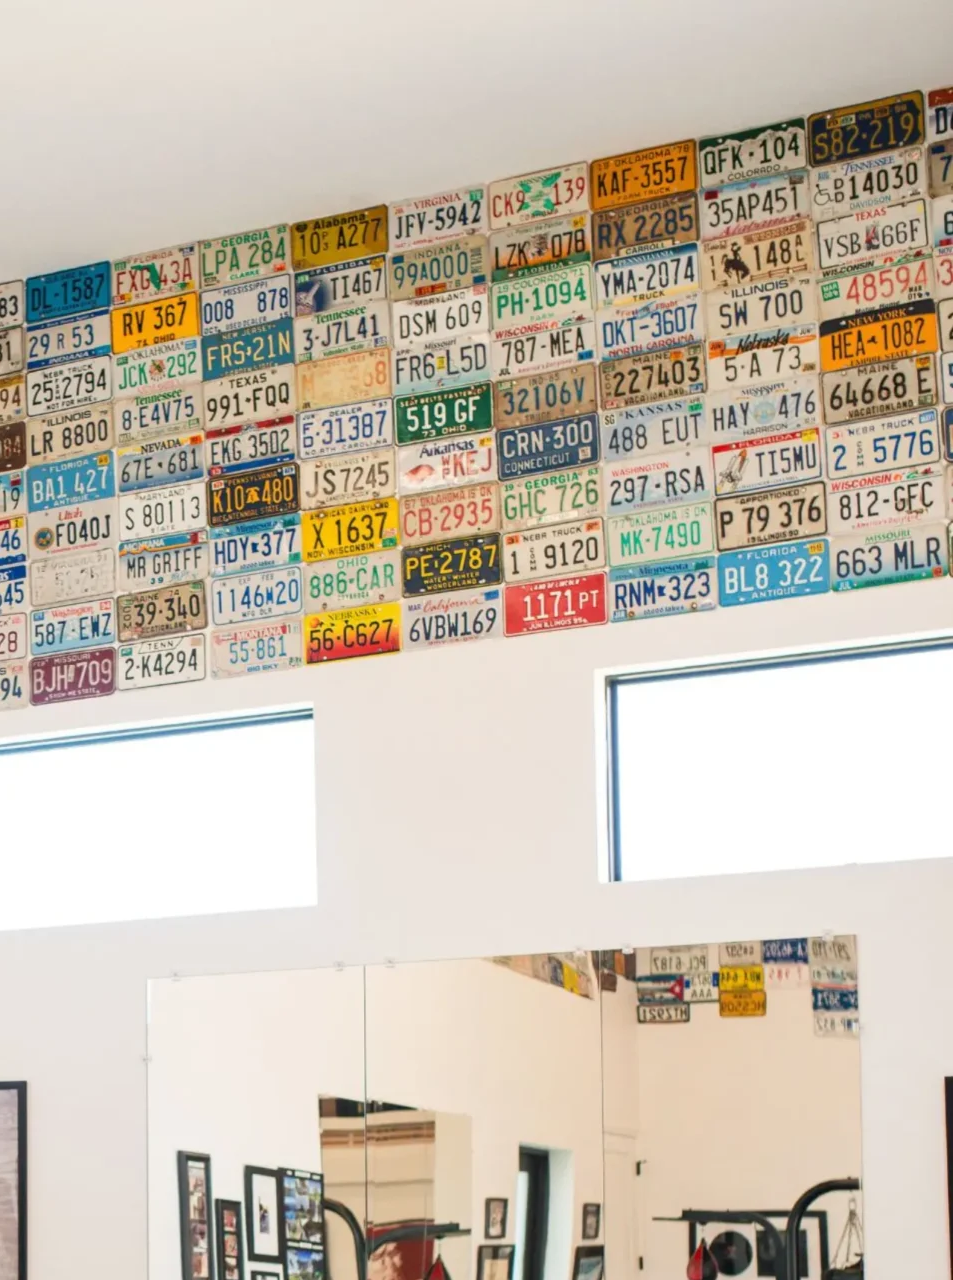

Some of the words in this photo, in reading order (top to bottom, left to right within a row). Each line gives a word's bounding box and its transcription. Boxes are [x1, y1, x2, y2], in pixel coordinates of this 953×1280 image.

[597, 156, 686, 196] KAF-3557
[727, 164, 781, 181] COLORADO
[849, 162, 917, 199] 14030
[414, 193, 460, 208] VIRGINIA
[709, 185, 797, 226] 35AP451
[855, 206, 886, 221] TEXAS
[313, 211, 366, 230] Alabama
[337, 217, 380, 248] A277
[396, 200, 480, 238] JFV-5942
[598, 220, 627, 248] RX
[632, 205, 694, 241] 2285
[221, 231, 268, 247] GEORGIA
[414, 243, 460, 258] INDIANA
[202, 247, 240, 276] LPA
[248, 237, 285, 267] 284
[223, 281, 267, 295] MISSISSIPPI
[731, 279, 788, 297] ILLINOIS
[846, 262, 926, 301] 48594
[122, 310, 144, 335] RV
[153, 300, 186, 329] 367
[314, 306, 365, 323] Tennessee
[399, 309, 436, 338] DSM
[445, 300, 481, 329] 609
[719, 300, 747, 328] SW
[762, 289, 802, 320] 700
[846, 313, 876, 327] NEW
[876, 306, 908, 321] YORK
[602, 304, 696, 347] DKT-3607
[118, 362, 147, 389] JCK
[166, 351, 196, 378] 292
[229, 372, 266, 387] TEXAS
[613, 356, 699, 396] 227403
[134, 389, 181, 405] Tennessee
[830, 372, 906, 409] 64668
[917, 365, 932, 395] E
[406, 402, 446, 431] 519
[454, 395, 479, 422] GF
[713, 402, 748, 430] HAY
[778, 390, 815, 417] 476
[31, 432, 52, 456] LR
[62, 419, 107, 448] 8800
[609, 424, 647, 453] 488
[662, 412, 700, 444] EUT
[847, 425, 874, 435] NEBR
[881, 418, 913, 428] TRUCK
[141, 438, 182, 454] NEVADA
[211, 438, 241, 465] EKG
[248, 429, 288, 458] 3502
[419, 440, 473, 457] Arkansas
[504, 452, 568, 472] CONNECTICUT
[833, 445, 846, 470] 2
[873, 429, 932, 462] 5776
[524, 472, 579, 489] GEORGIA
[611, 462, 668, 476] WASHINGTON
[831, 474, 891, 490] WISCONSIN
[142, 496, 199, 526] 80113
[720, 511, 732, 537] P
[742, 505, 769, 533] 79
[779, 496, 820, 527] 376
[335, 511, 386, 544] 1637
[127, 556, 145, 577] MR
[153, 546, 201, 573] GRIFF
[214, 537, 248, 564] HDY
[261, 528, 295, 556] 377
[336, 555, 367, 569] OHIO
[544, 536, 598, 568] 9120
[836, 546, 881, 577] 663
[894, 537, 940, 570] MLR
[639, 561, 687, 576] Minnesota
[725, 563, 767, 593] BL8
[779, 553, 822, 585] 322
[615, 580, 655, 608] RNM
[669, 572, 709, 600] 323
[51, 604, 93, 619] Washington
[328, 608, 376, 621] NEBRASKA
[409, 608, 495, 641] 6VBW169
[147, 639, 173, 650] TENN
